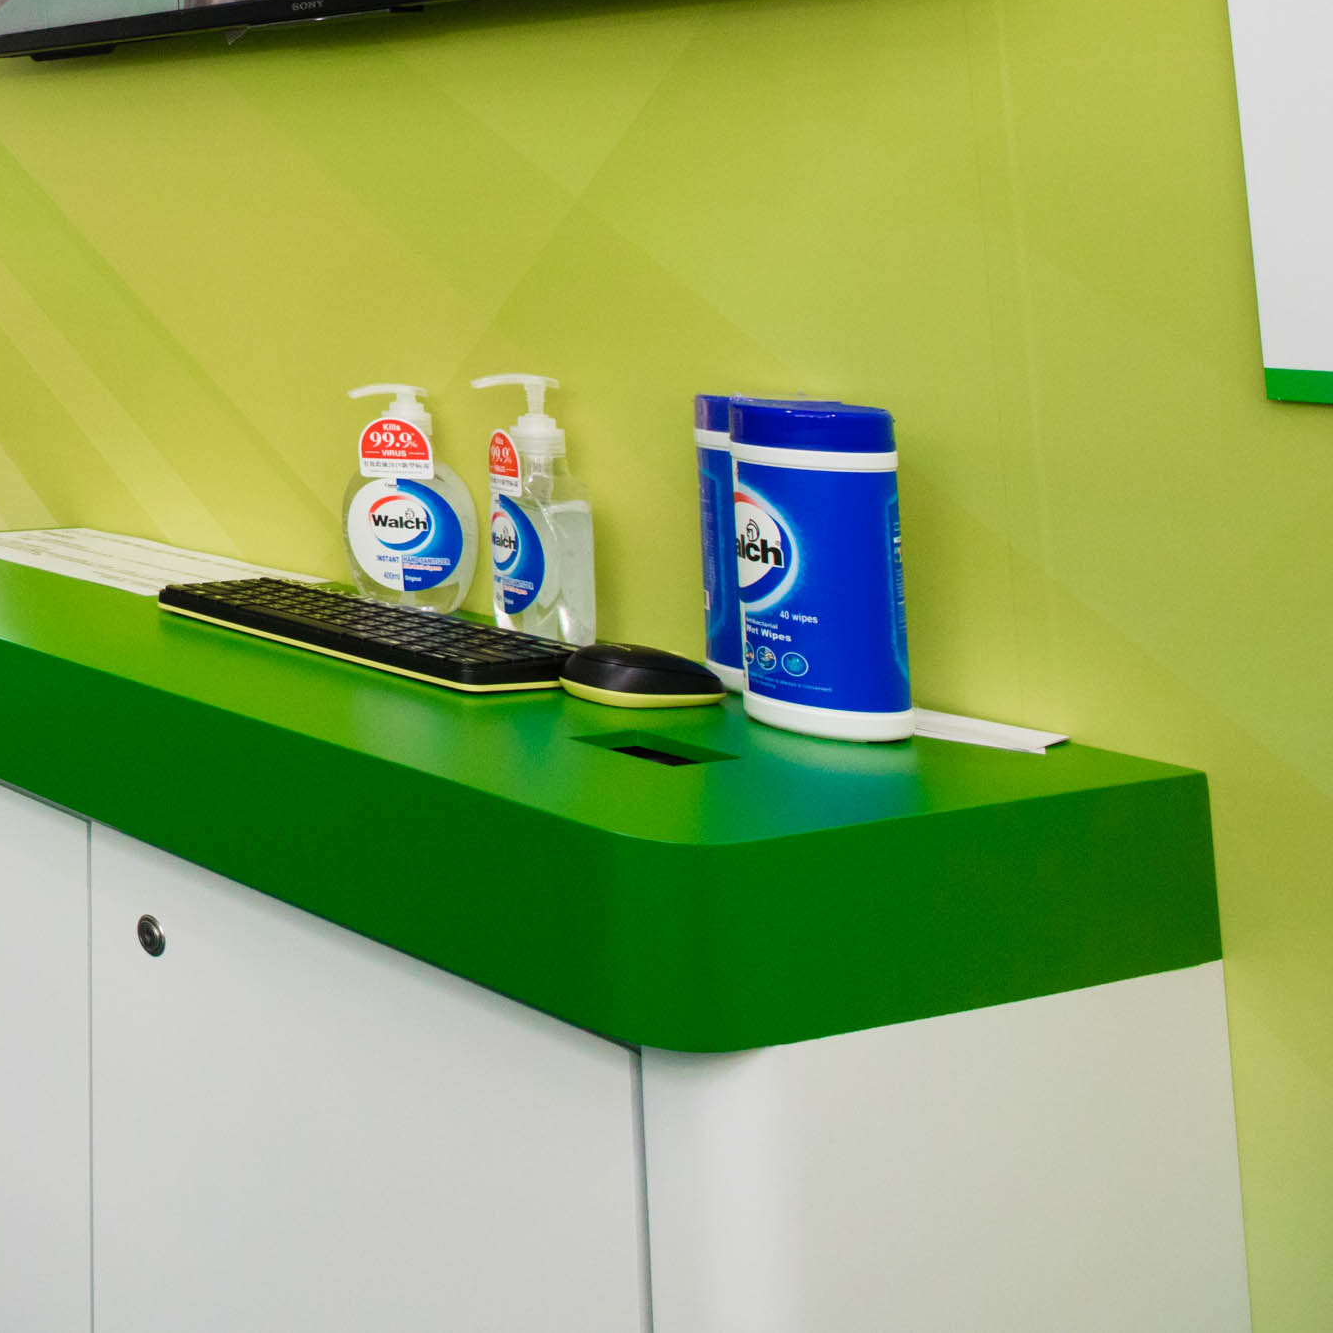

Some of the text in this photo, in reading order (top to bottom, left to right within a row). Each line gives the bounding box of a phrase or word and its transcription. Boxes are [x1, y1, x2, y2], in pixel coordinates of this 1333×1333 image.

[291, 0, 325, 12] SONY
[382, 423, 402, 432] Kills
[381, 449, 407, 457] VIRUS
[371, 514, 428, 530] Walch
[779, 610, 819, 624] 40 wipes
[761, 628, 793, 642] Wipes
